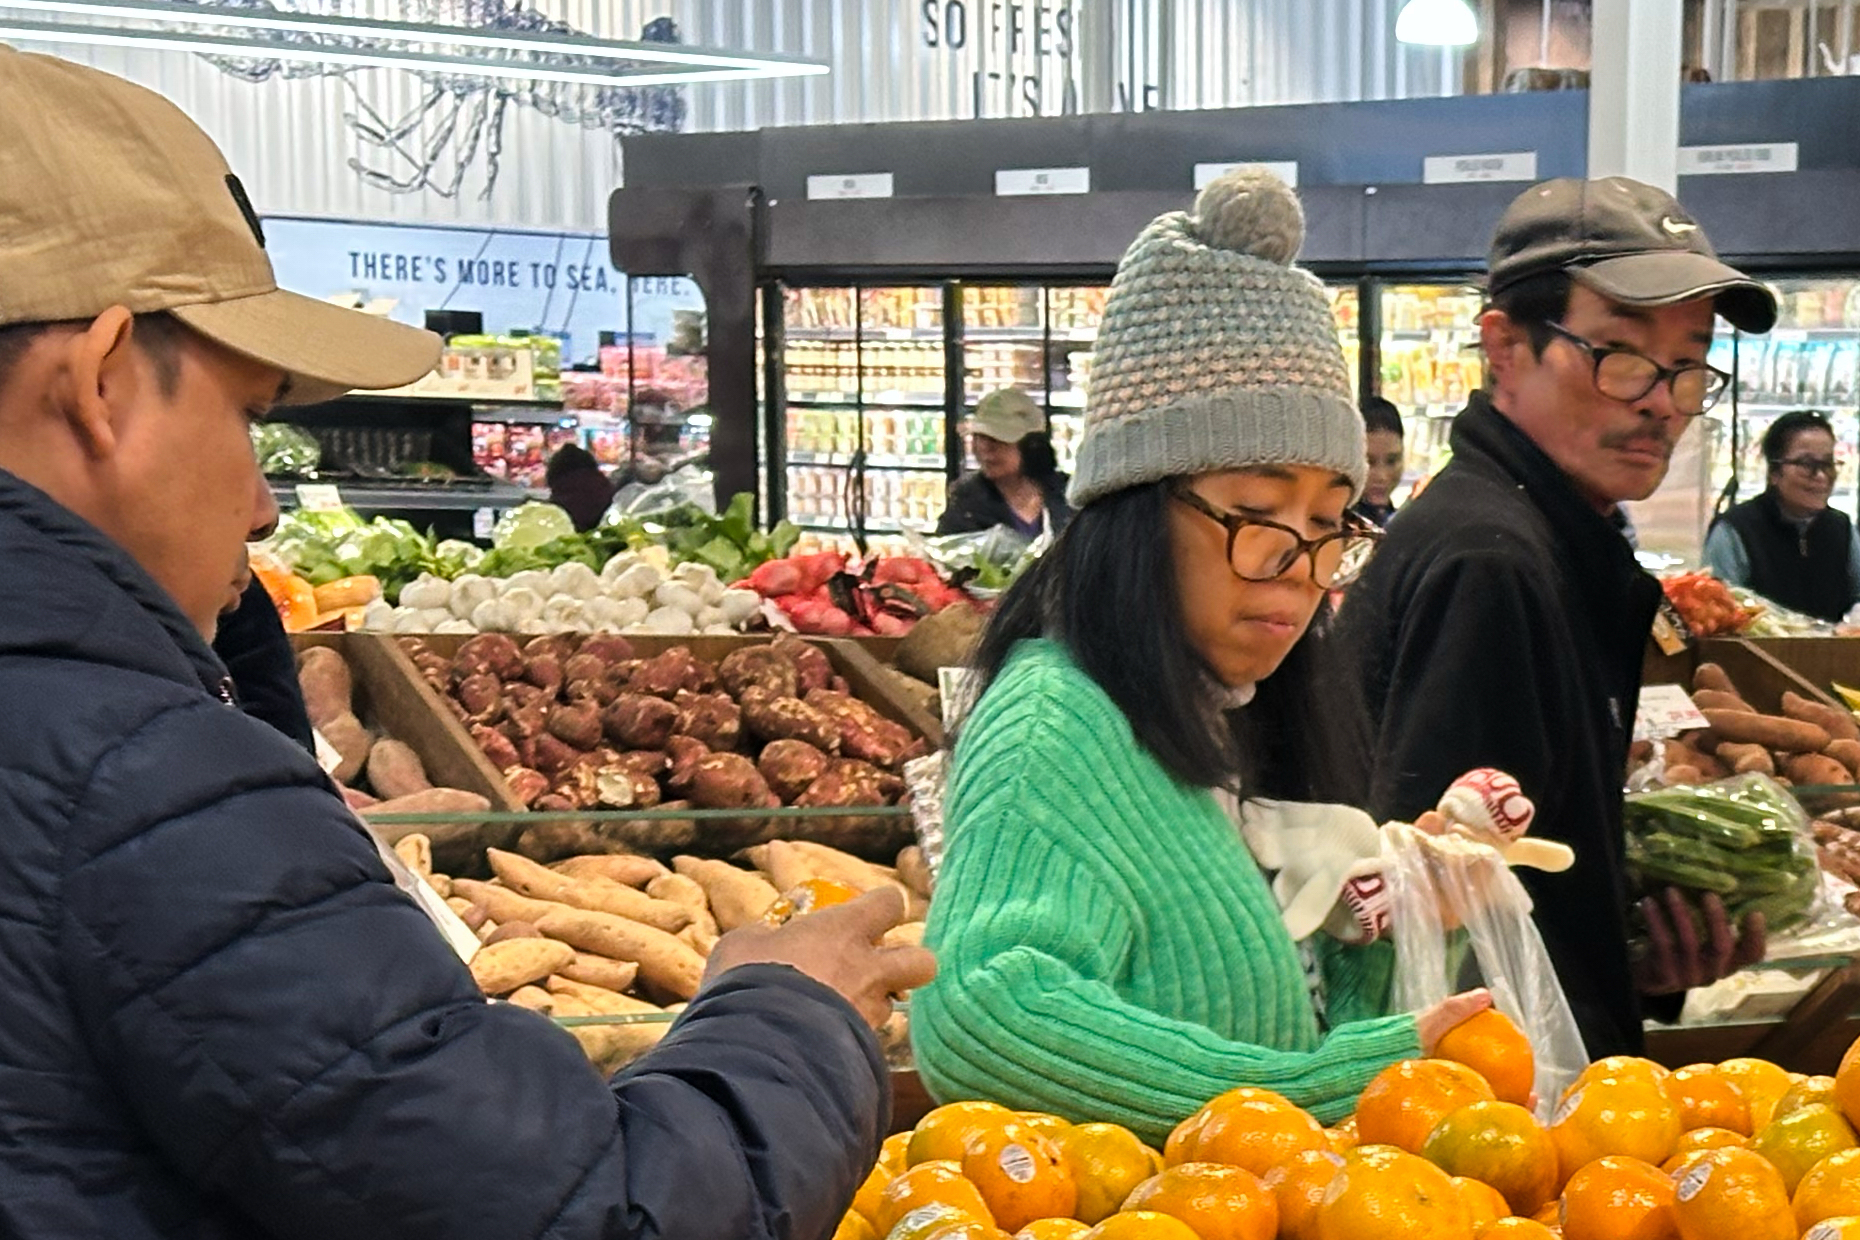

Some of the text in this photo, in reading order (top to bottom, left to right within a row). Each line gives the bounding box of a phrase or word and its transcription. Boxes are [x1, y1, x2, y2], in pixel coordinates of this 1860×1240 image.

[348, 251, 447, 284] THERE'S
[458, 259, 519, 288] MORE
[530, 263, 557, 289] TO
